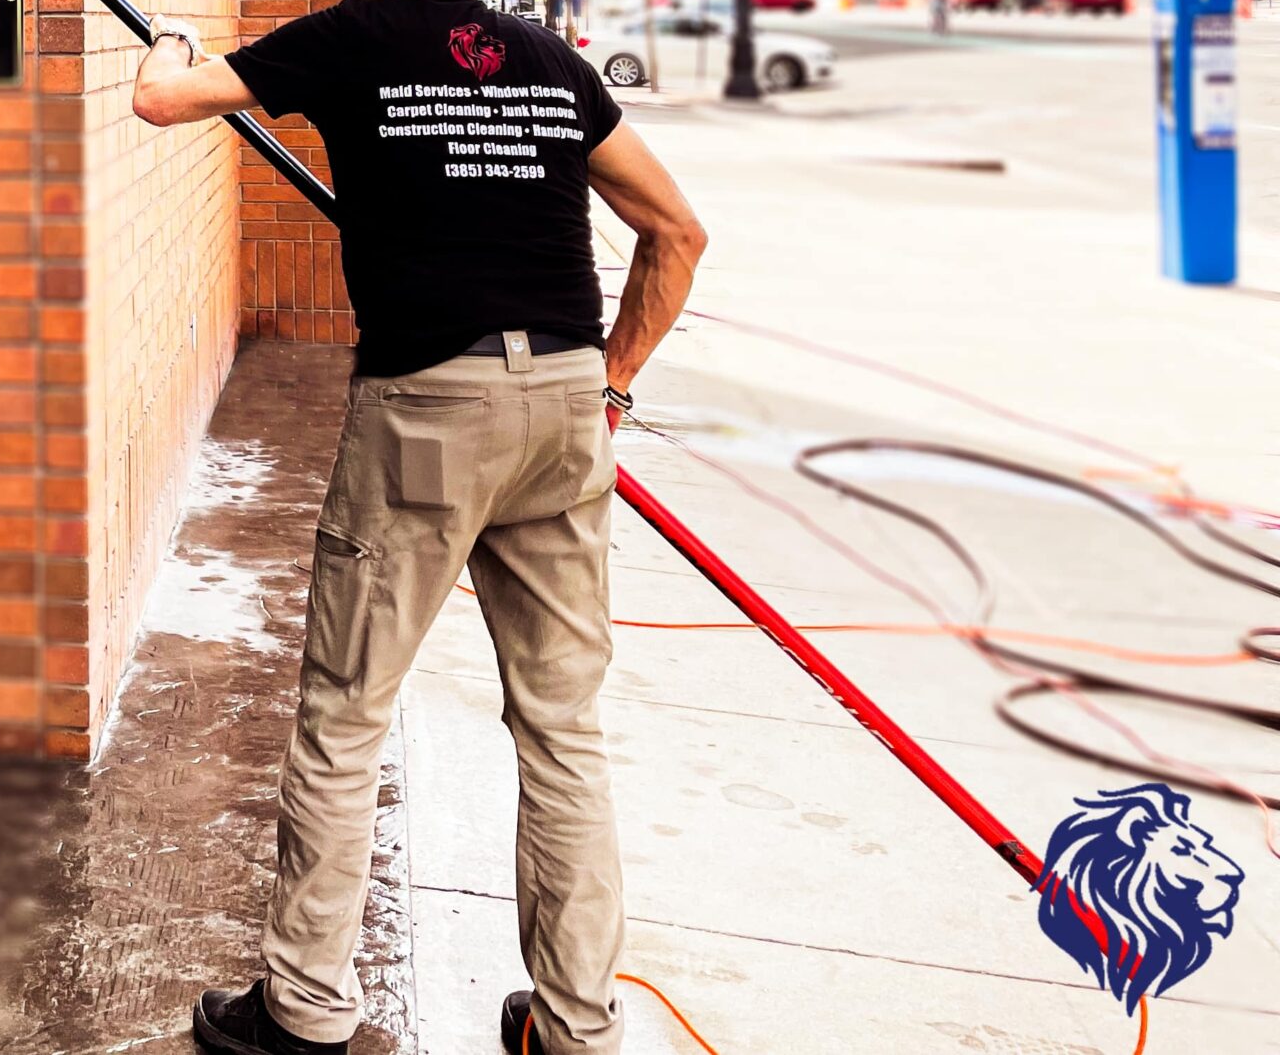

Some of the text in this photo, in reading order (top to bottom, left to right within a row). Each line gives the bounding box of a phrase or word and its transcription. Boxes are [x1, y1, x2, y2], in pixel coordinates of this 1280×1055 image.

[379, 84, 576, 103] Maid Services Window Cleaning
[387, 104, 433, 118] Carpet
[434, 103, 492, 118] Cleaning
[501, 104, 531, 117] Junk
[379, 122, 465, 138] Construction
[467, 122, 523, 138] Cleaning
[448, 142, 537, 157] Floor Cleaning
[445, 163, 545, 179] (385) 343-2599
